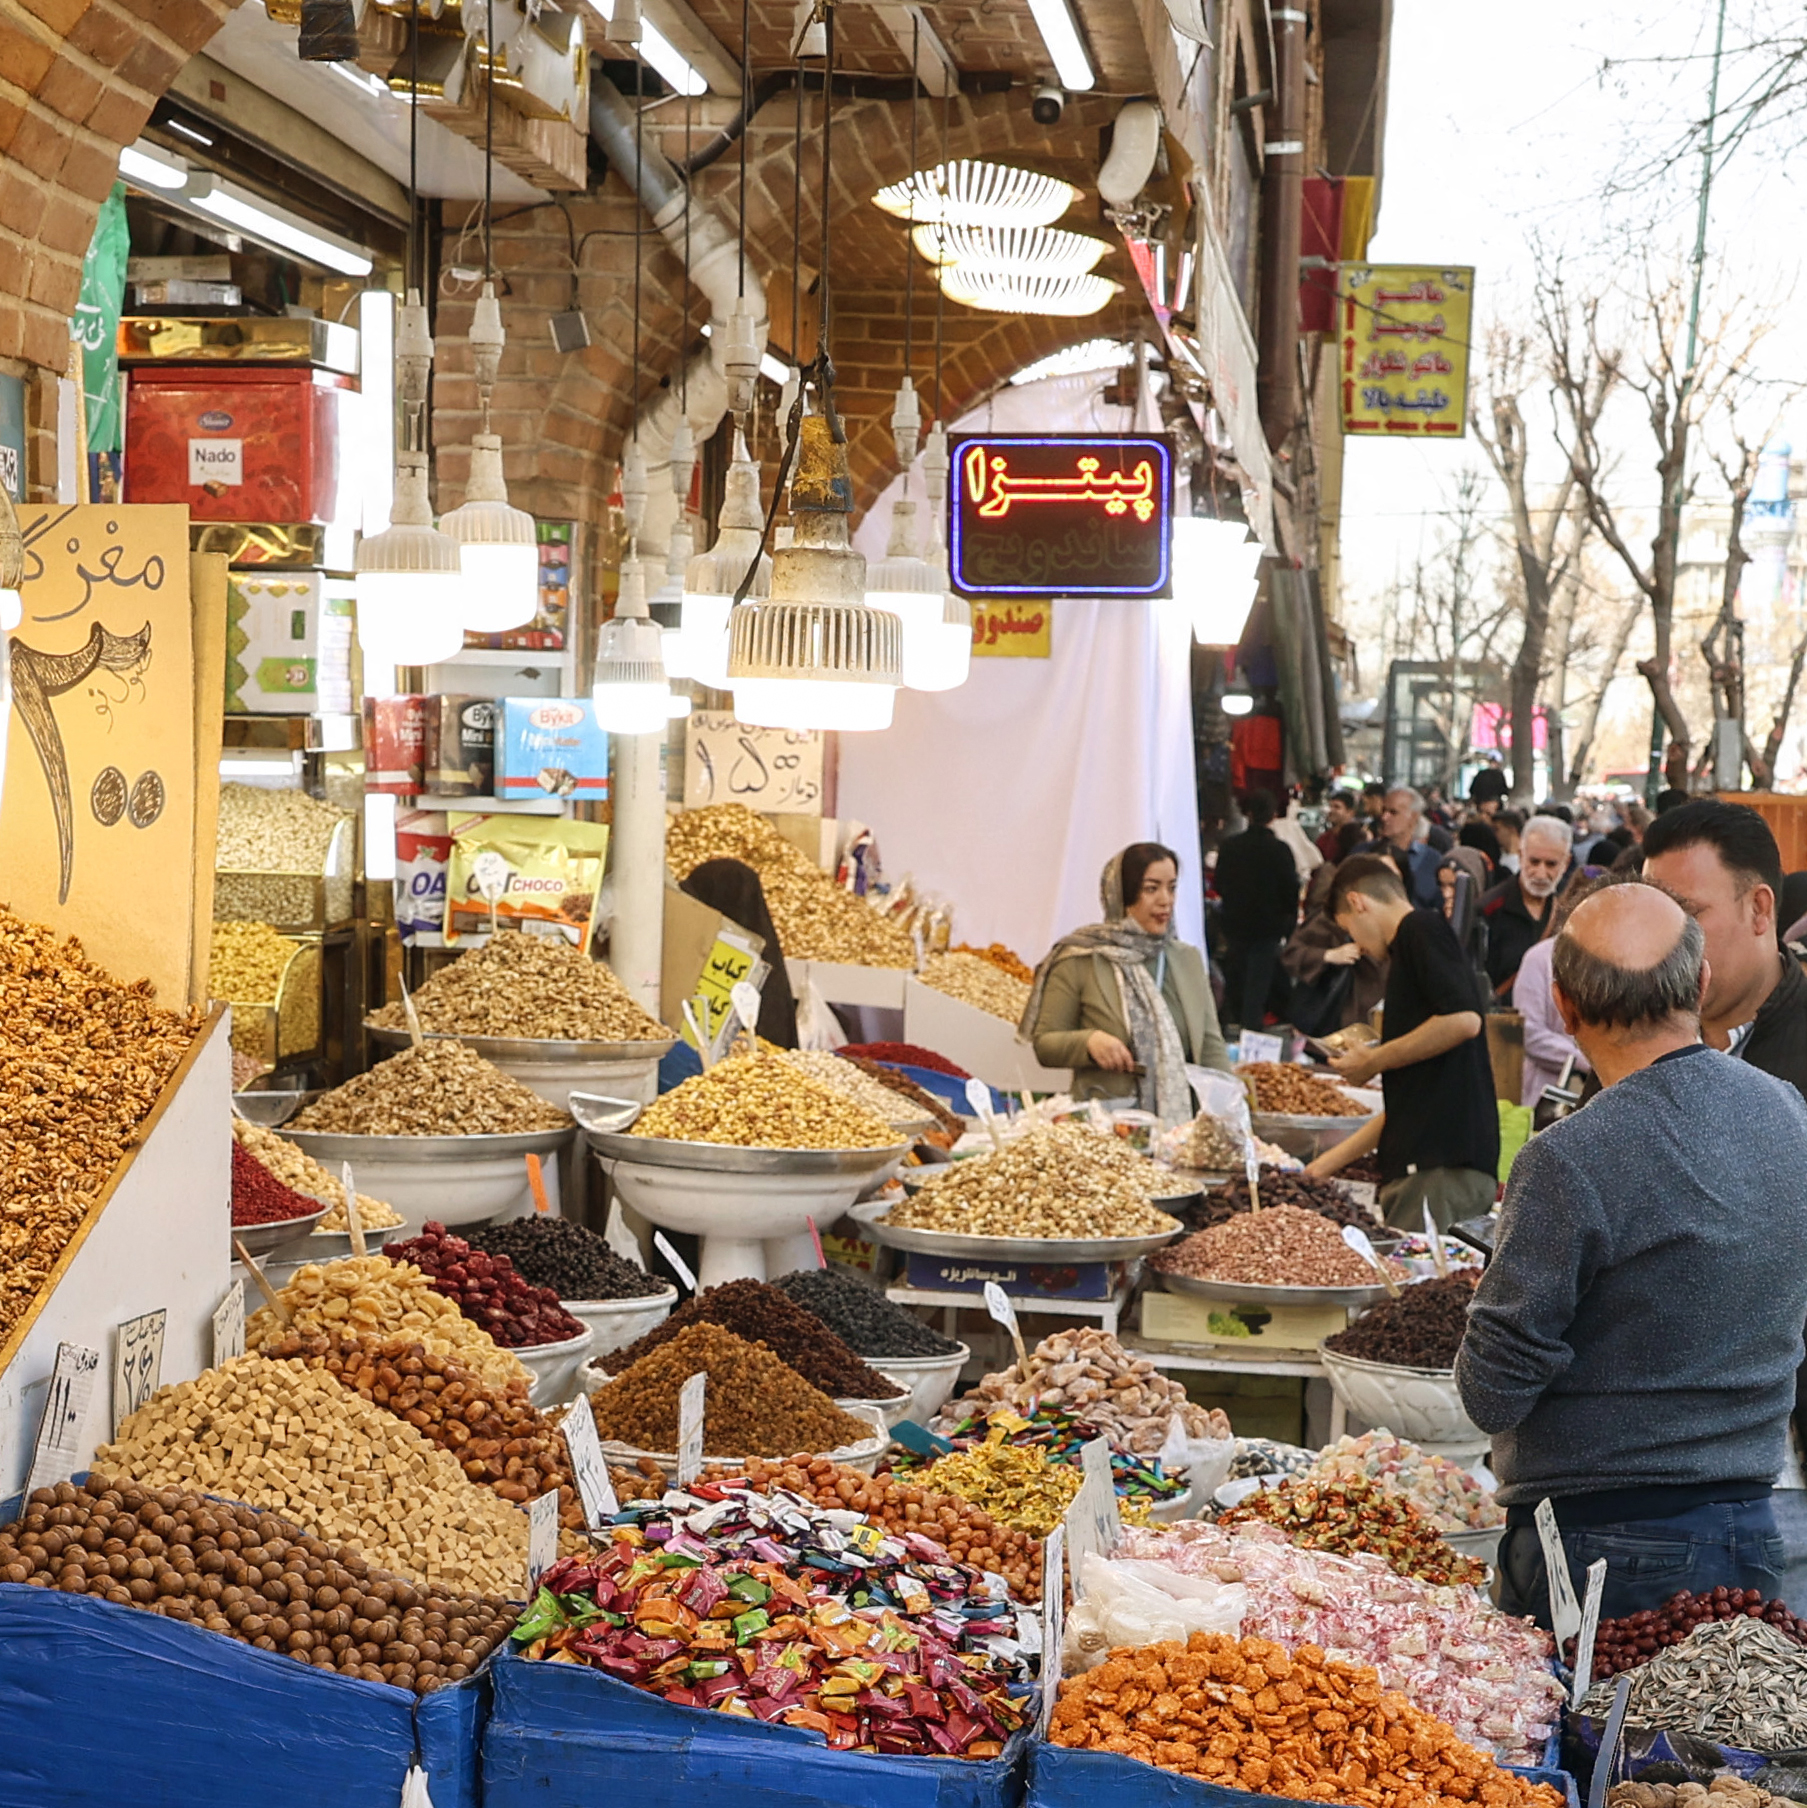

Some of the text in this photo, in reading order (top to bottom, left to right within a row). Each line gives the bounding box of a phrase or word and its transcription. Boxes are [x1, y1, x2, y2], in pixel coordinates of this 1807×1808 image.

[195, 448, 236, 464] Nado
[966, 446, 1155, 522] پیتزا
[32, 520, 165, 623] مغز
[539, 708, 576, 730] Bykit
[411, 872, 446, 897] OA
[511, 879, 564, 894] CHOCO
